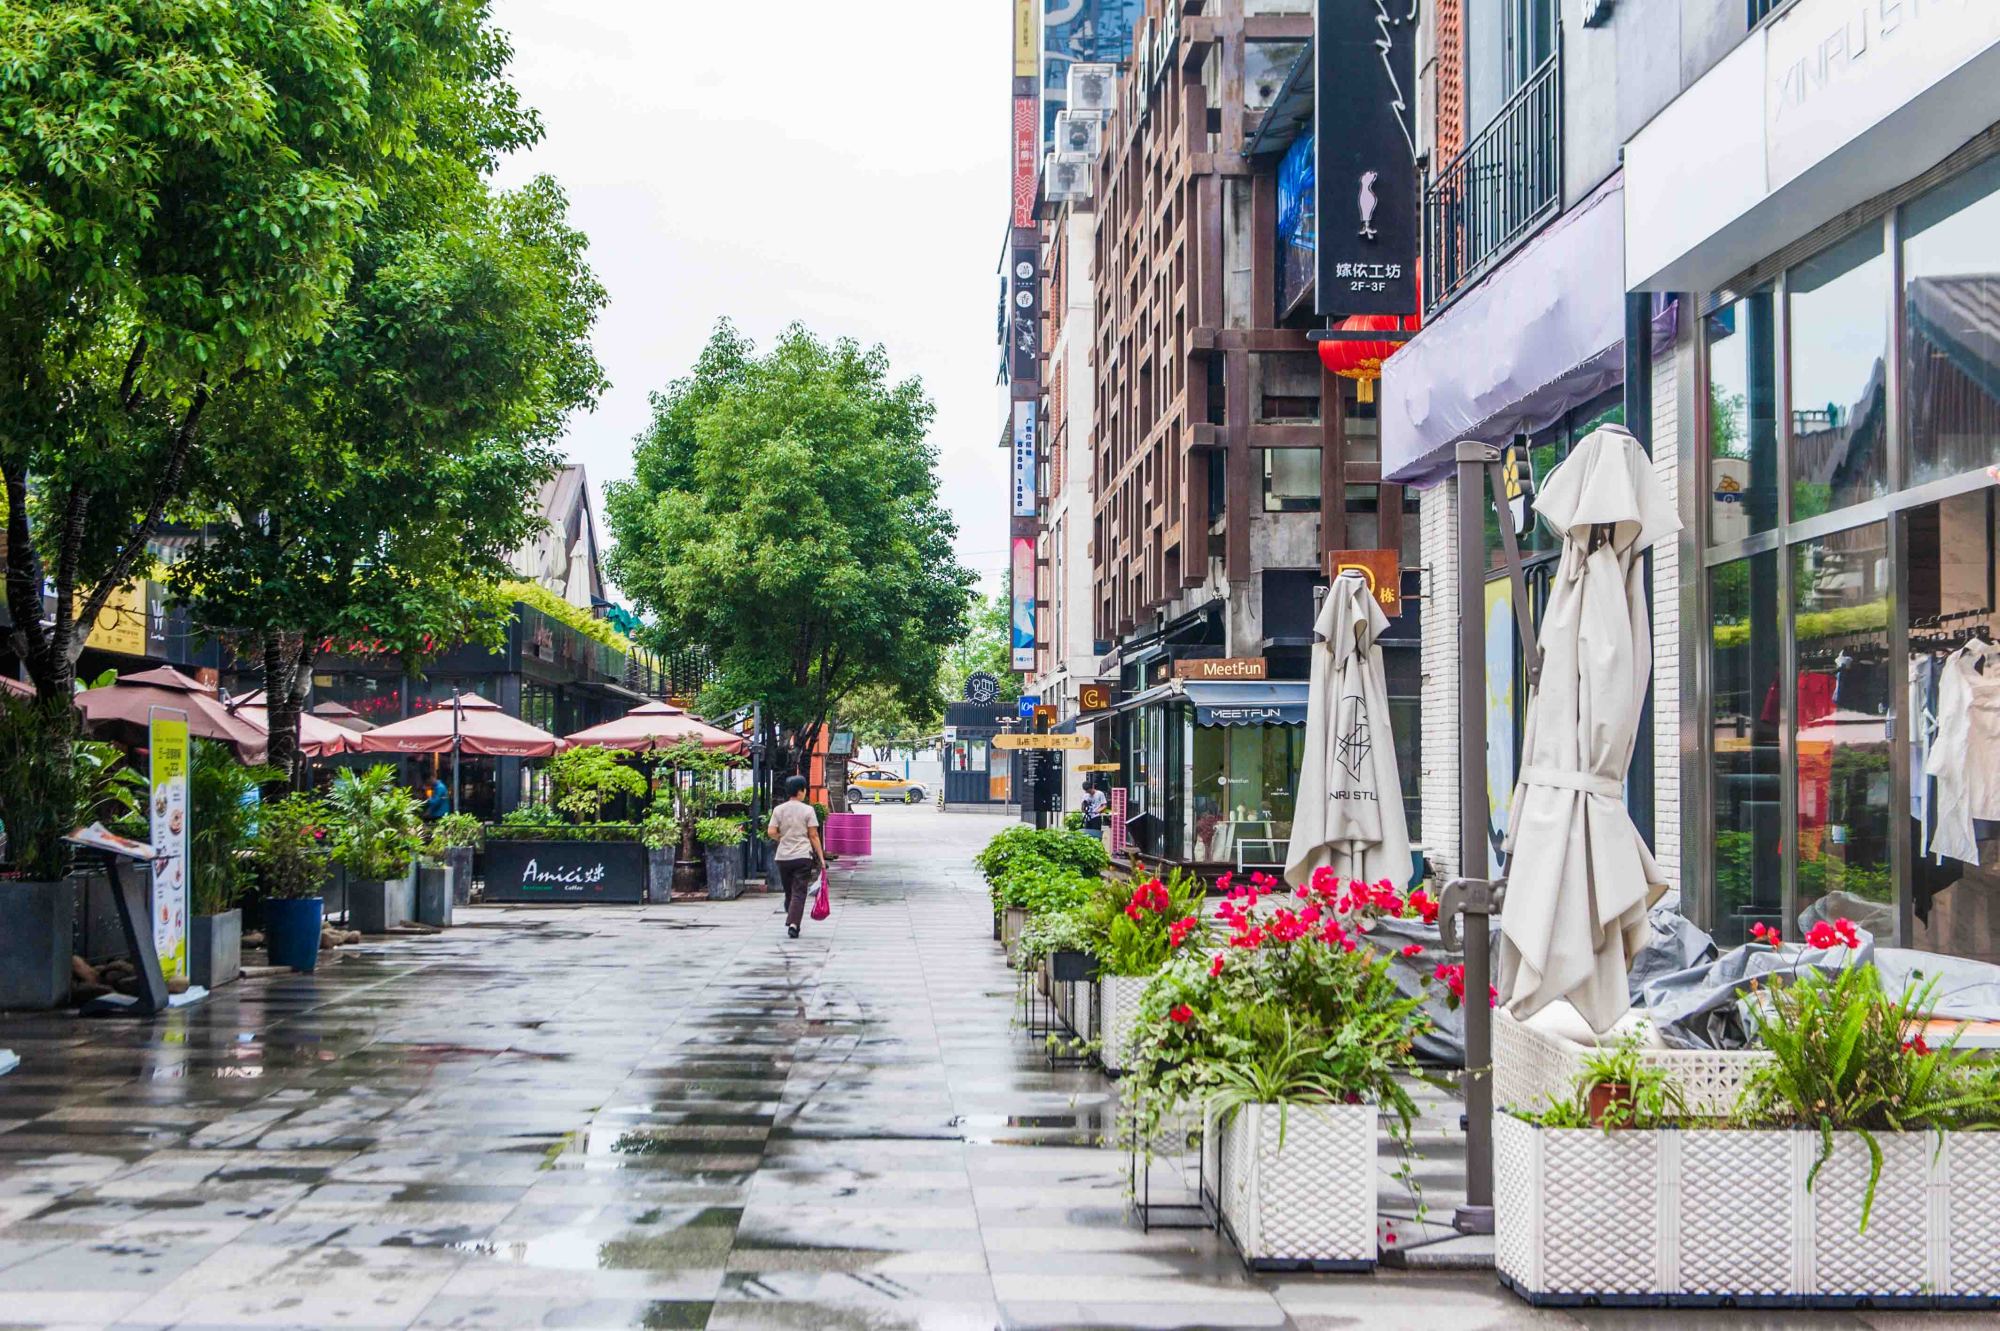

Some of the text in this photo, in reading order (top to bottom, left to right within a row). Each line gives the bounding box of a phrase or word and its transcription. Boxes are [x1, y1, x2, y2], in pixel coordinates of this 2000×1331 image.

[1335, 262, 1401, 278] 嫁依工坊
[1350, 281, 1386, 292] 2F-3F
[1203, 662, 1261, 676] MeetFun
[1084, 689, 1099, 708] C
[1211, 708, 1281, 718] MEETFUN
[522, 858, 583, 882] Amici
